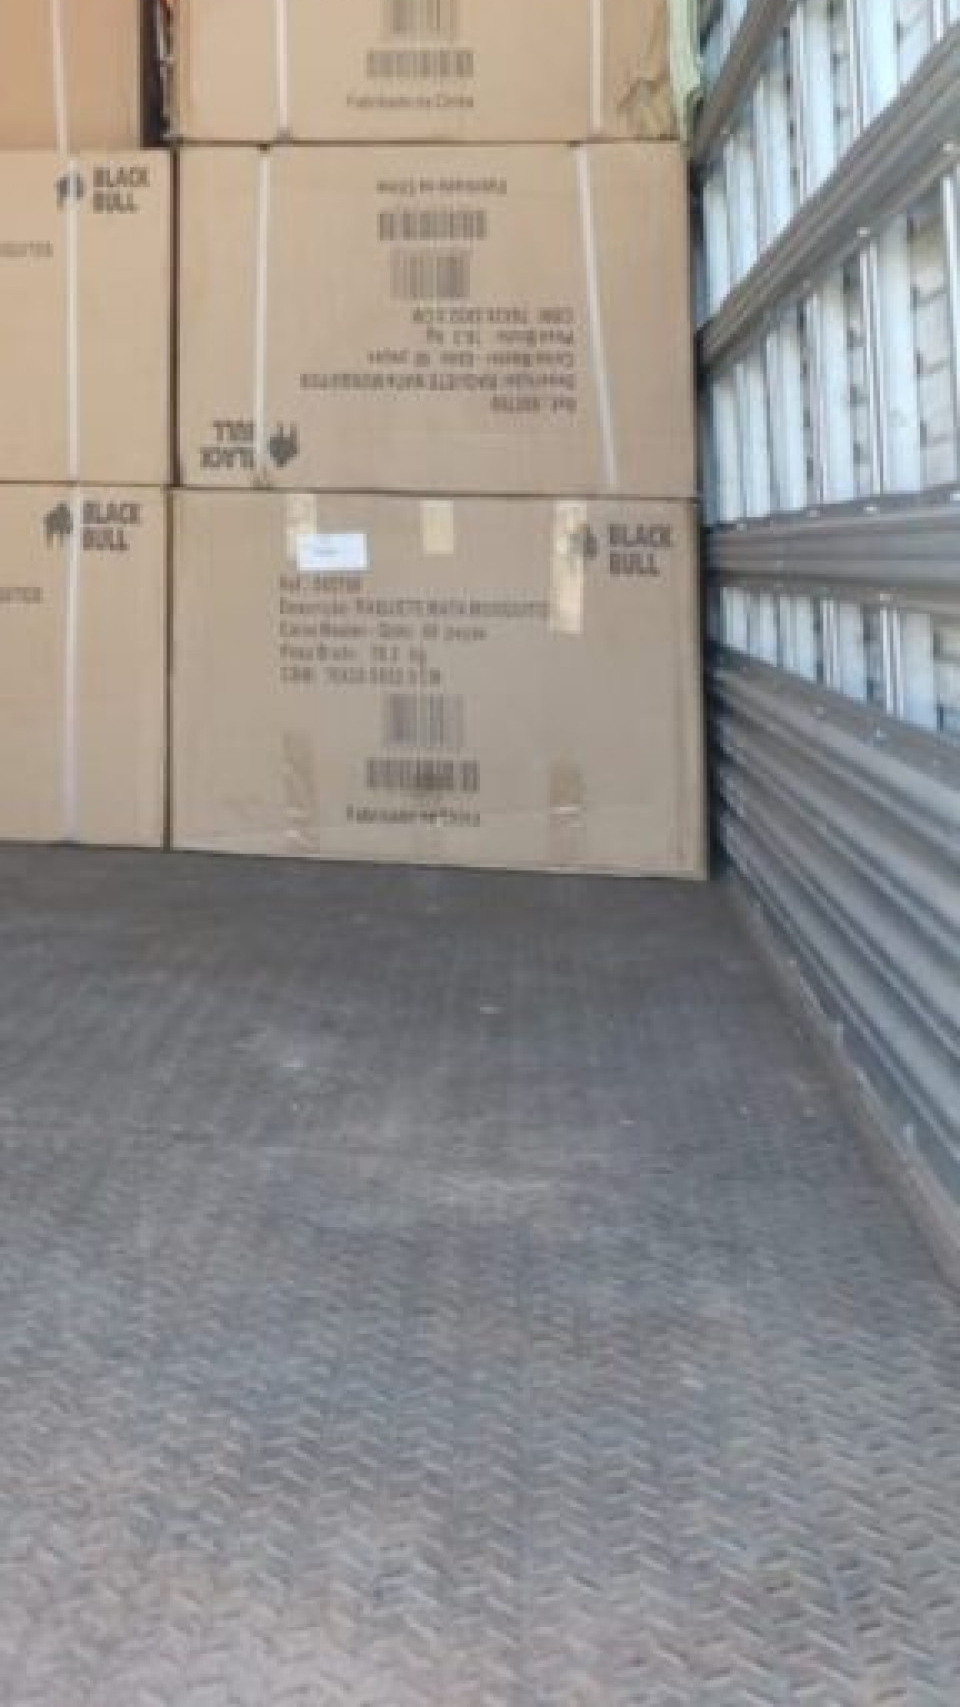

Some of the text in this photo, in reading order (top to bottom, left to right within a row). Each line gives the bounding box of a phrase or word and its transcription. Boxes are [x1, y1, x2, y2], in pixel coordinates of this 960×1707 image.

[93, 167, 150, 186] BLACK
[93, 193, 138, 213] BULL
[83, 502, 142, 525] BLACK
[83, 528, 129, 550] BULL
[608, 524, 671, 547] BLACK
[609, 553, 660, 576] BULL
